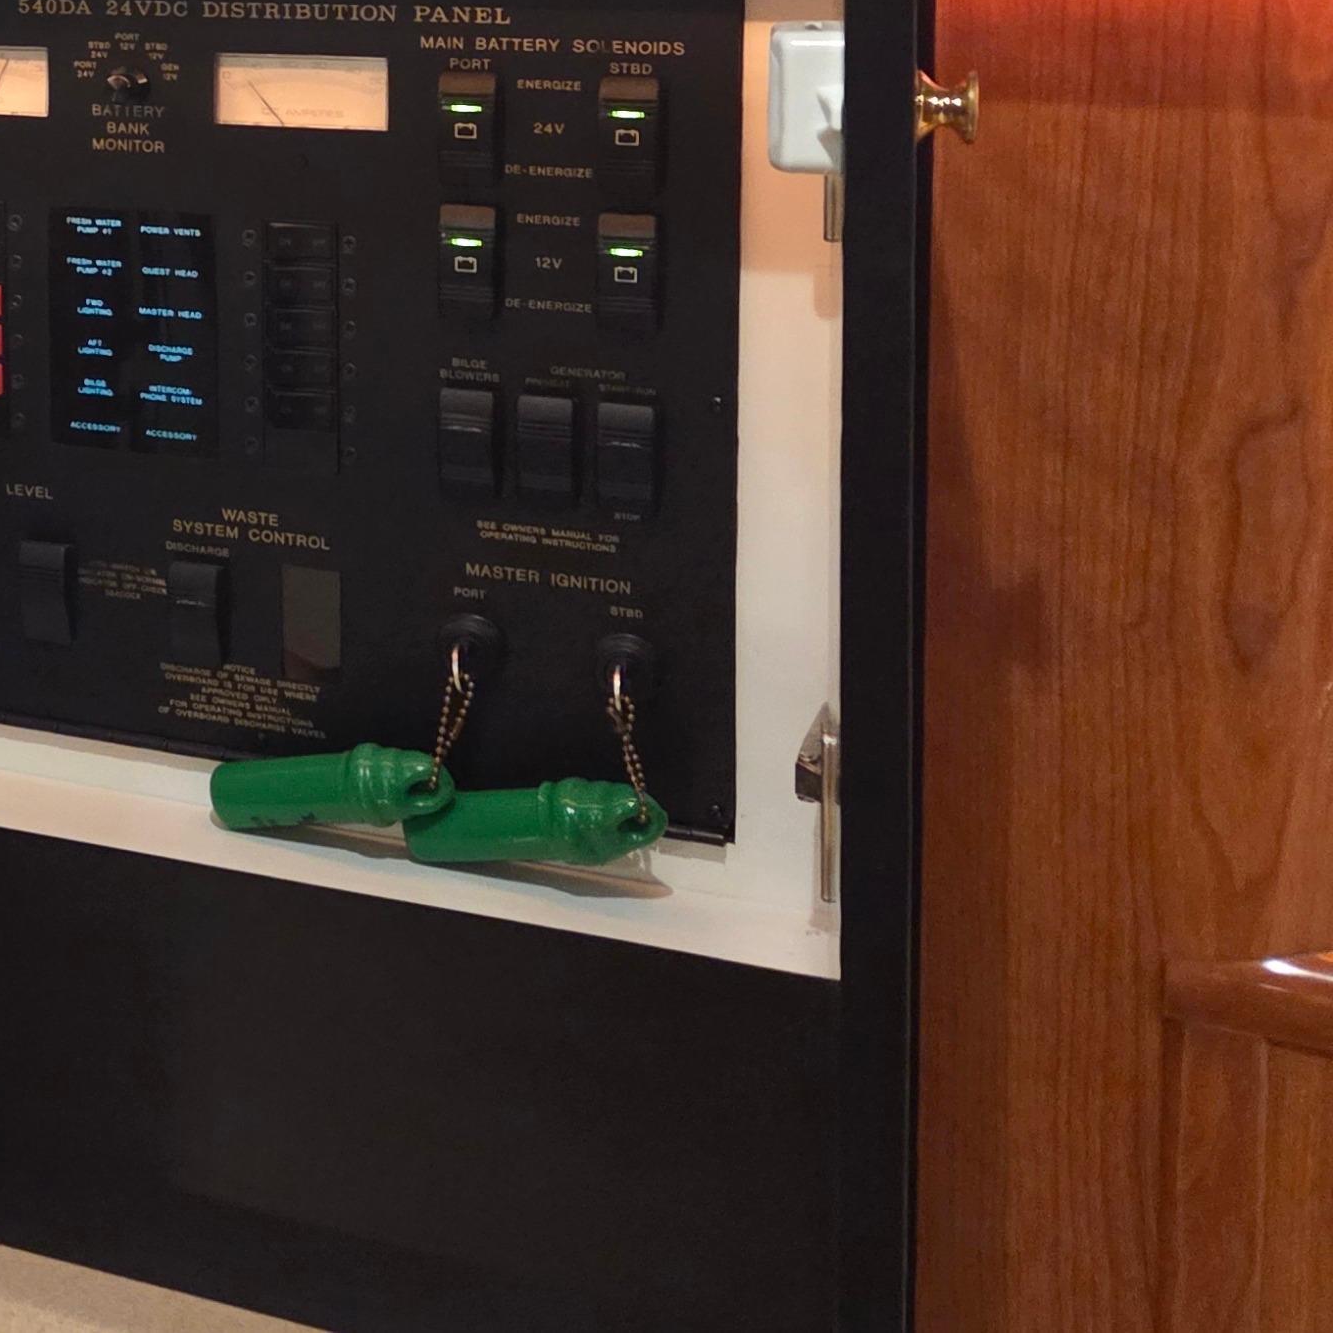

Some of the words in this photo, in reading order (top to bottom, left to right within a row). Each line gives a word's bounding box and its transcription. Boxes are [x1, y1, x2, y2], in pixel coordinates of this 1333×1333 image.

[104, 0, 188, 18] 24VDC
[201, 1, 398, 24] DISTRIBUTION
[412, 6, 512, 27] PANEL
[114, 32, 139, 41] PORT
[419, 35, 465, 52] MAIN
[474, 36, 562, 54] BATTERY
[571, 39, 687, 58] SOLENOIDS
[448, 57, 491, 71] PORT
[608, 61, 654, 77] STBD
[516, 78, 582, 92] ENERGIZE
[91, 103, 166, 119] BATTERY
[106, 120, 151, 136] BANK
[532, 122, 565, 135] 24V
[91, 137, 166, 154] MONITOR
[503, 164, 594, 180] DE-ENERGIZE
[65, 215, 92, 225] FRESH
[94, 217, 122, 227] WATER
[516, 212, 582, 228] ENERGIZE
[76, 225, 98, 234] PUMP
[139, 224, 170, 235] POWER
[173, 227, 202, 237] VENTS
[65, 255, 92, 265] FRESH
[94, 257, 122, 267] WATER
[533, 256, 563, 270] 12V
[75, 265, 98, 274] PUMP
[140, 265, 171, 276] GUEST
[174, 268, 199, 278] HEAD
[76, 306, 114, 317] LIGHTING
[137, 306, 175, 317] MASTER
[177, 309, 203, 320] HEAD
[503, 298, 593, 314] DE-ENERGIZE
[76, 346, 114, 357] LIGHTING
[148, 343, 194, 355] DISCHARGE
[159, 353, 182, 362] PUMP
[451, 356, 487, 370] BILGE
[437, 367, 502, 385] BLOWERS
[548, 365, 629, 382] GENERATOR
[77, 385, 114, 396] LIGHTING
[139, 391, 168, 401] PHONE
[170, 394, 203, 405] SYSTEM
[69, 420, 121, 433] ACCESSORY
[144, 428, 197, 441] ACCESSORY
[4, 482, 55, 501] LEVEL
[221, 507, 280, 528] WASTE
[172, 517, 240, 540] SYSTEM
[247, 527, 332, 552] CONTROL
[479, 529, 538, 545] OPERATING
[540, 536, 618, 554] INSTRUCTIONS
[550, 527, 592, 540] MANUAL
[597, 533, 619, 543] FOR
[163, 538, 231, 559] DISCHARGE
[464, 561, 541, 584] MASTER
[549, 571, 633, 596] IGNITION
[453, 585, 487, 601] PORT
[608, 604, 645, 620] STBD
[221, 662, 256, 675] NOTICE
[159, 661, 213, 678] DISCHARGE
[232, 673, 272, 685] SEWAGE
[276, 678, 322, 694] DIRECTLY
[163, 671, 221, 688] OVERBOARD
[236, 681, 256, 692] FOR
[282, 689, 318, 702] WHERE
[199, 685, 251, 702] APPROVED
[252, 693, 277, 705] ONLY
[174, 708, 231, 725] OVERBOARD
[190, 701, 245, 718] OPERATING
[245, 711, 315, 729] INSTRUCTIONS
